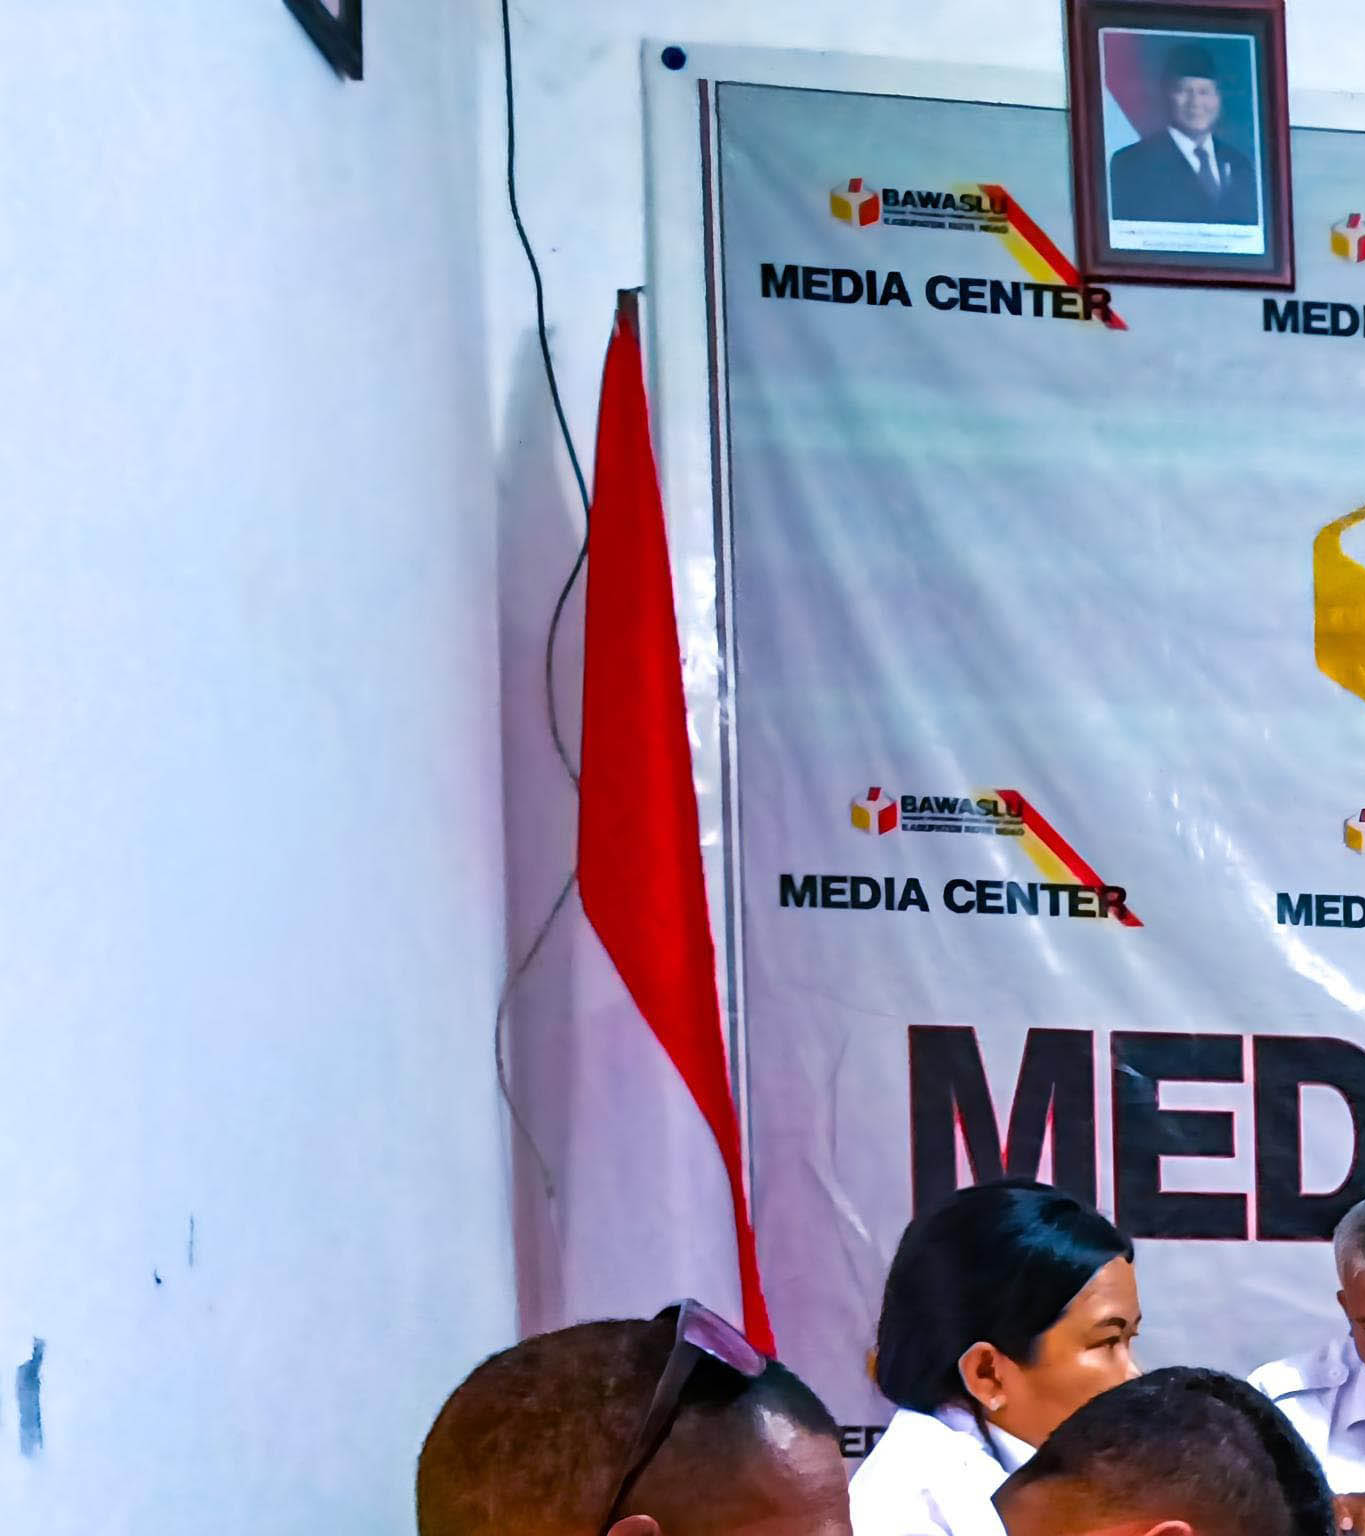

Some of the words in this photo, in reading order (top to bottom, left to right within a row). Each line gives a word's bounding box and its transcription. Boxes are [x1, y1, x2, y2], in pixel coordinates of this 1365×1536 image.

[882, 188, 1008, 214] BAWASLU
[760, 263, 912, 307] MEDIA
[925, 275, 1113, 320] CENTER
[901, 795, 1024, 818] BAWASLU
[780, 874, 929, 912] MEDIA
[943, 879, 1128, 920] CENTER
